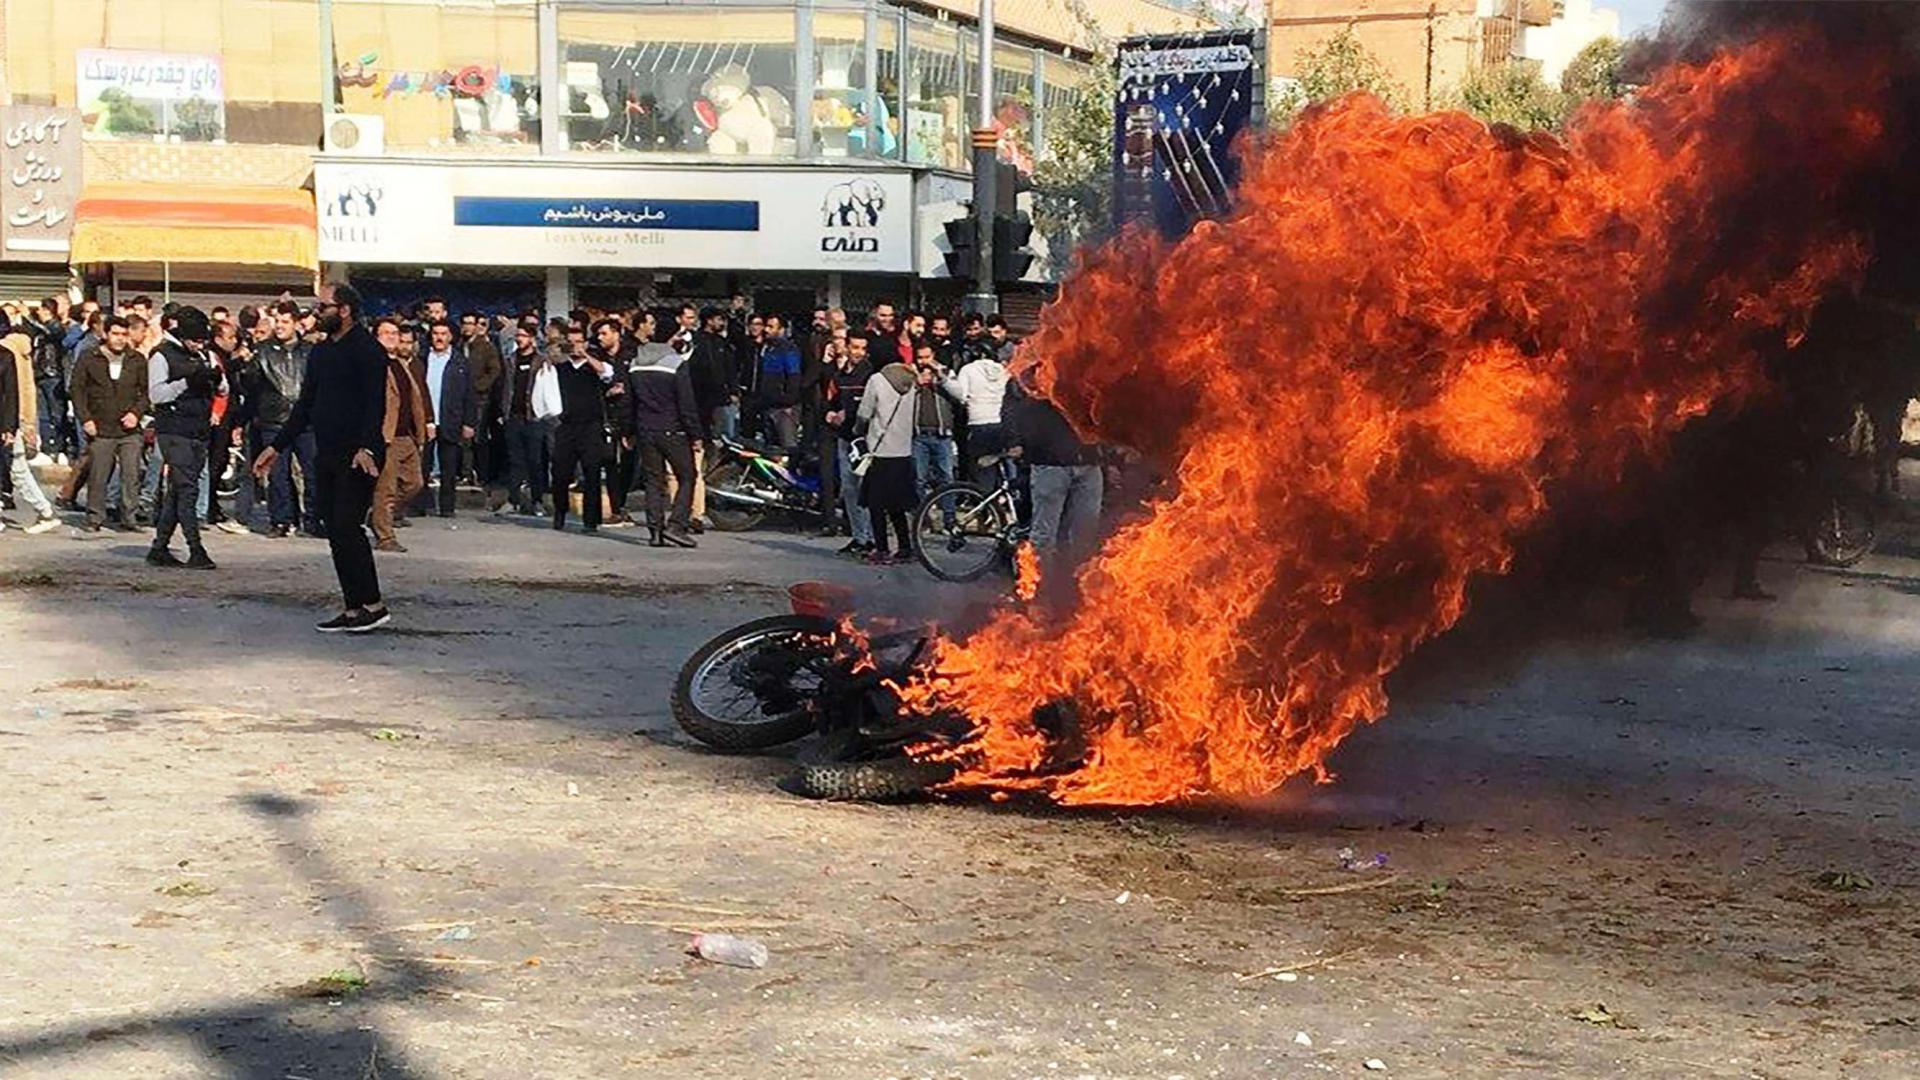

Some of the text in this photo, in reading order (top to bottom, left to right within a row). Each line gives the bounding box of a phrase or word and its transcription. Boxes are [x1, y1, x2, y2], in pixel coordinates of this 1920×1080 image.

[85, 58, 145, 87] عروسک
[190, 63, 217, 90] وای
[13, 151, 62, 185] ورزش
[32, 188, 43, 204] و
[10, 206, 66, 227] سلامت
[624, 231, 665, 244] Melli
